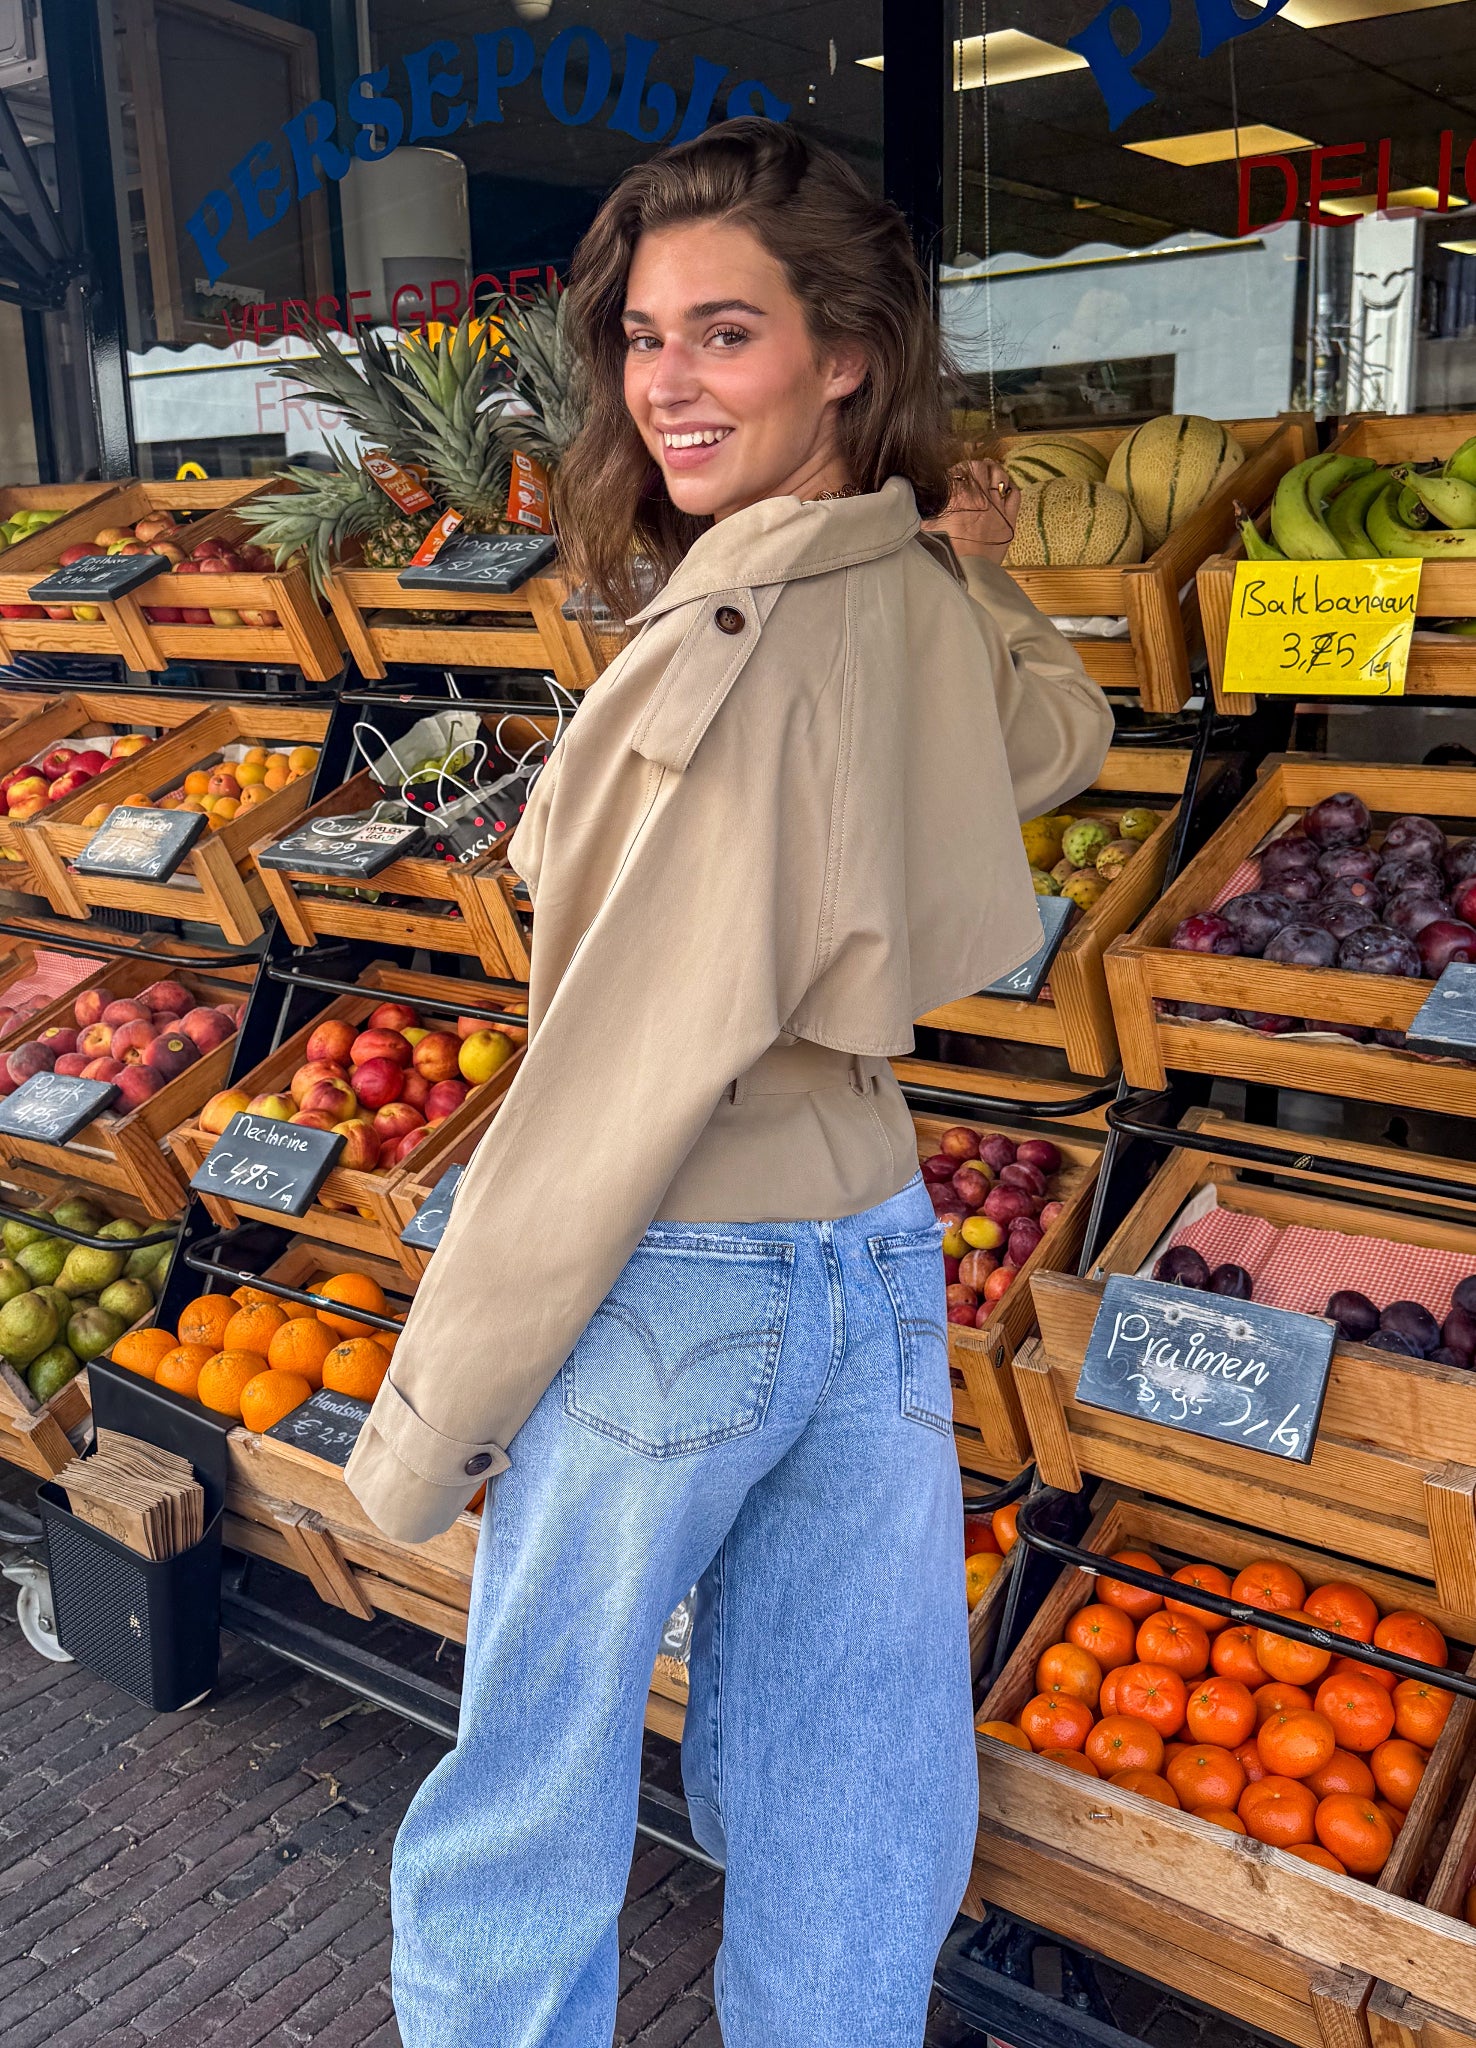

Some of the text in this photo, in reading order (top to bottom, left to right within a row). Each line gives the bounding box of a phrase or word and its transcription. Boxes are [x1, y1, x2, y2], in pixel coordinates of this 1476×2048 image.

[1238, 129, 1476, 237] DELI
[444, 535, 544, 552] Ananas
[279, 837, 306, 851] €
[23, 1075, 85, 1105] Perzik
[233, 1115, 309, 1152] Nectarine
[207, 1153, 233, 1177] €
[224, 1157, 279, 1190] 4,95
[293, 1419, 323, 1436] €
